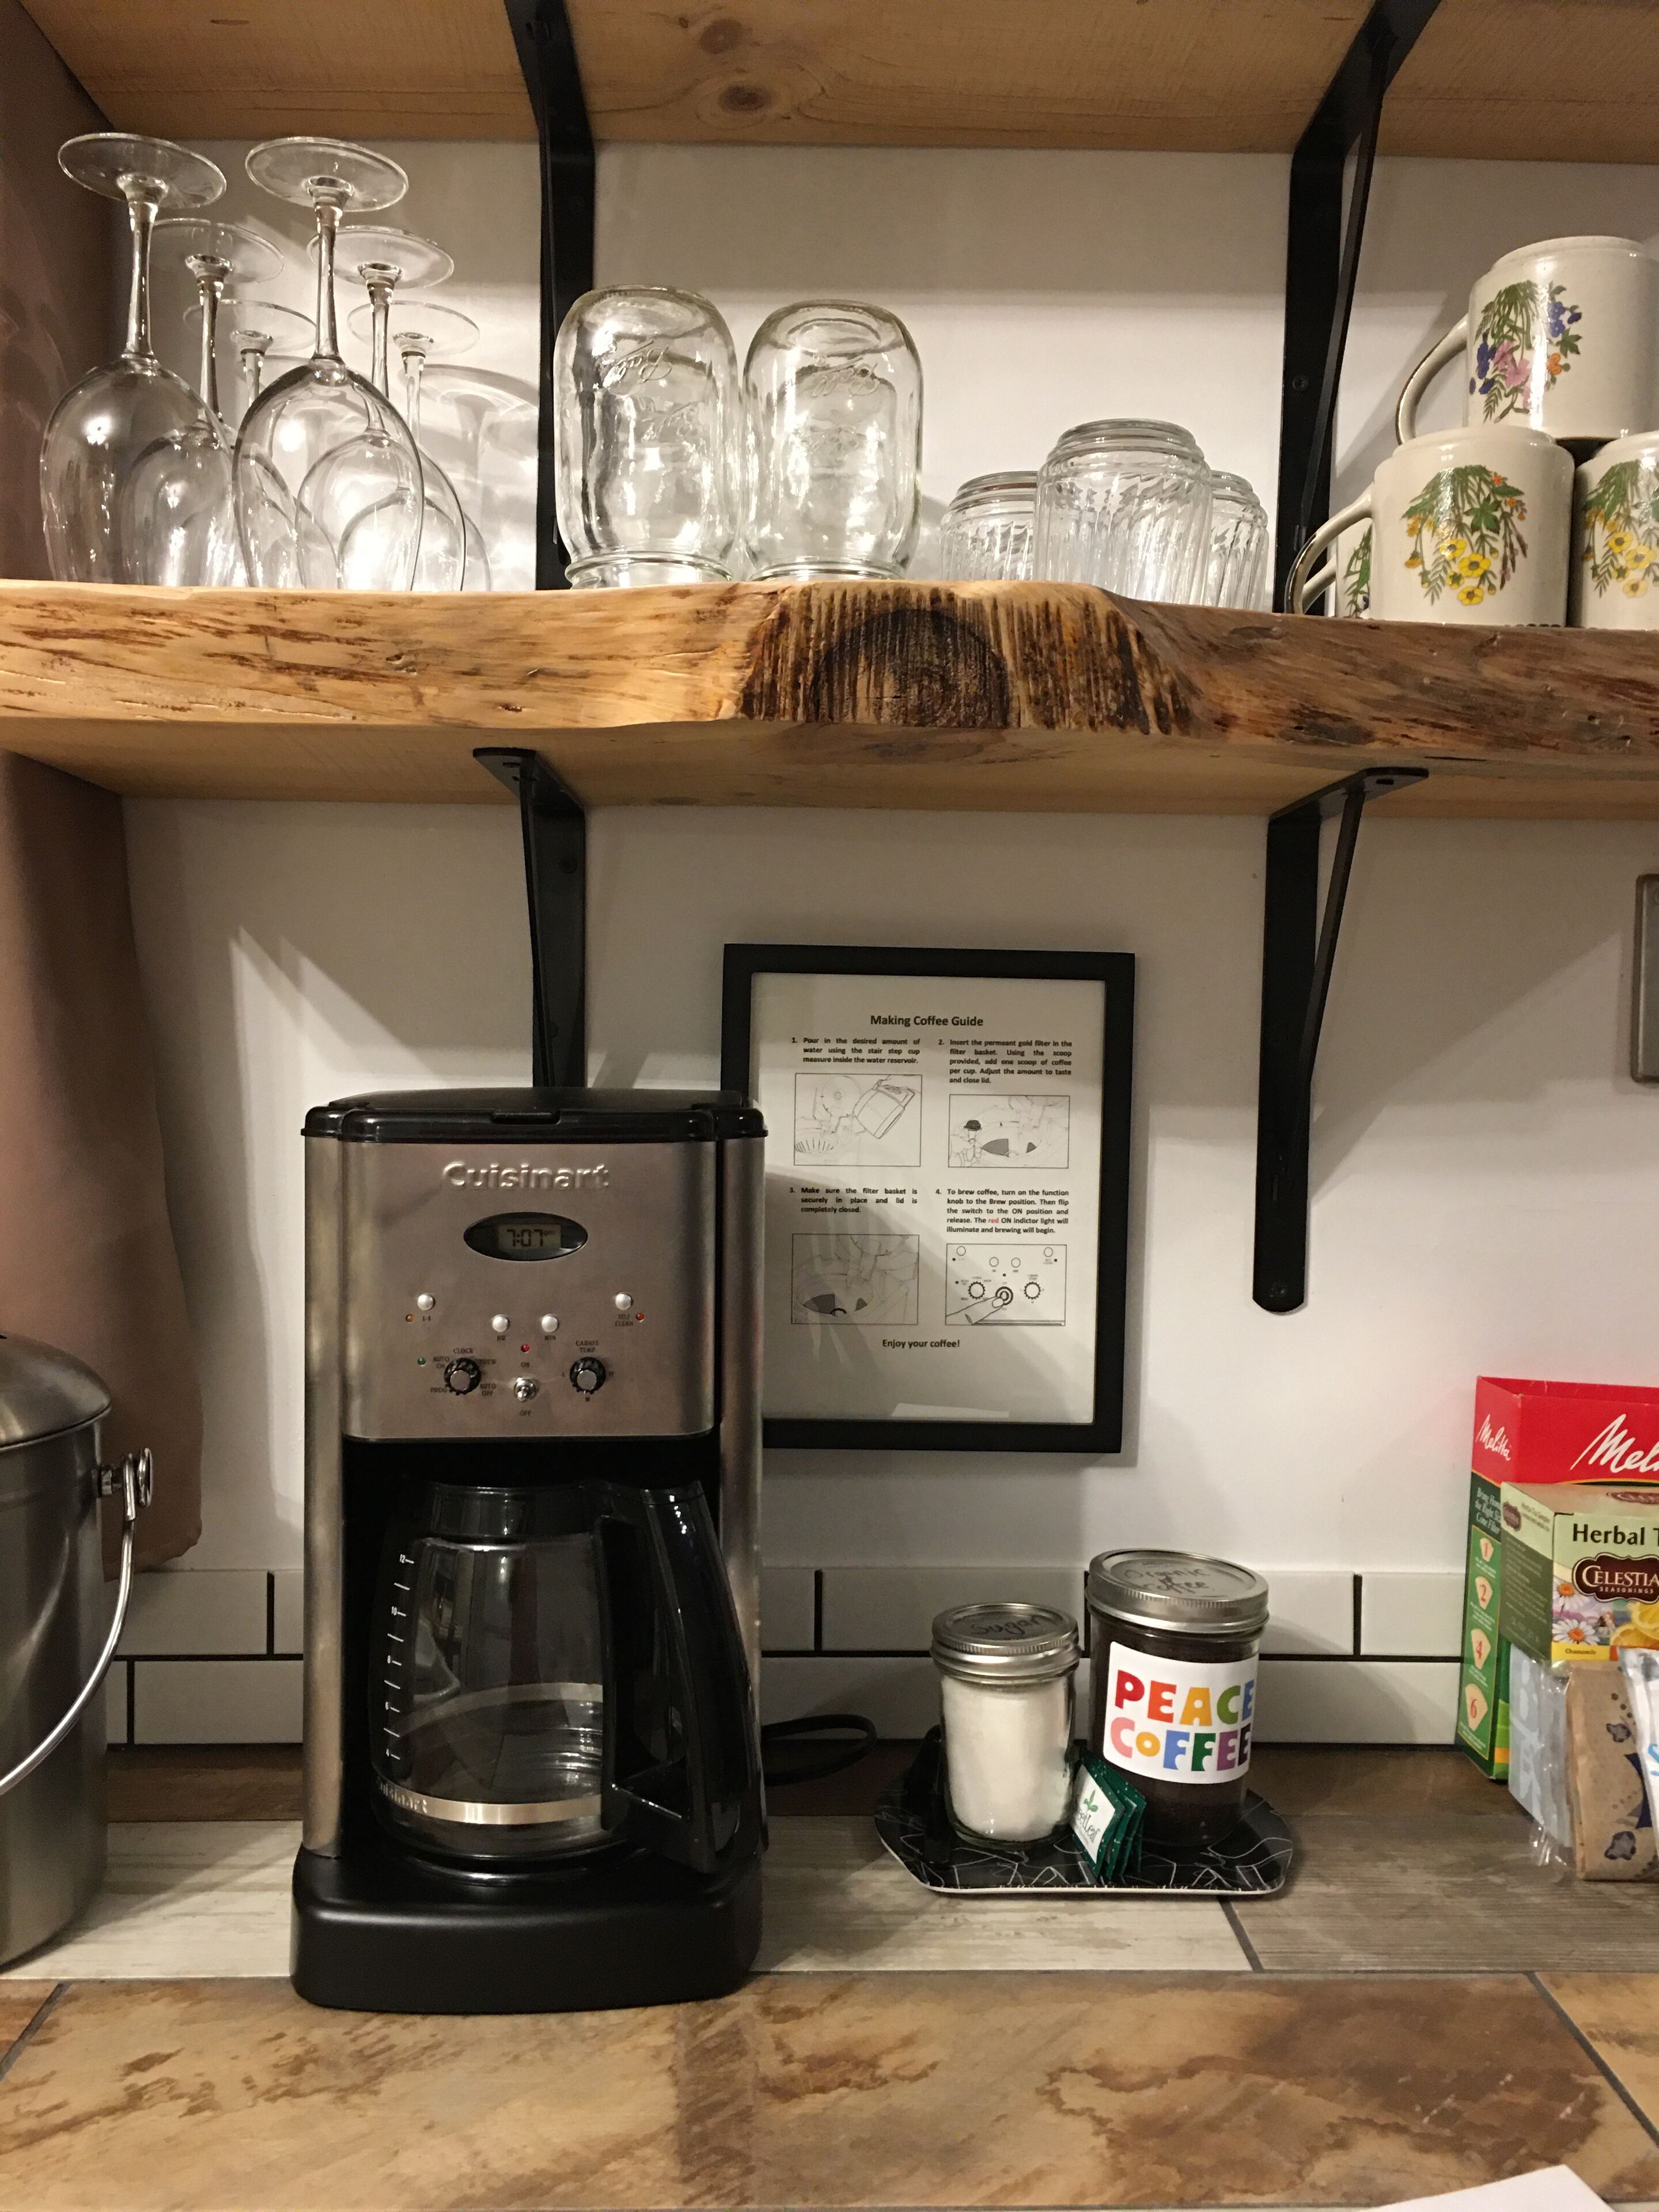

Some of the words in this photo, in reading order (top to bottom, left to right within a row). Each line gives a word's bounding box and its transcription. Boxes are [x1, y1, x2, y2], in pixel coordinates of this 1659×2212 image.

[870, 1015, 911, 1028] Making
[914, 1016, 948, 1026] Coffee
[952, 1016, 983, 1027] Guide
[853, 1037, 877, 1045] desired
[1018, 1039, 1032, 1048] gold
[1035, 1039, 1051, 1047] filter
[828, 1047, 846, 1055] using
[888, 1048, 902, 1056] step
[1007, 1049, 1025, 1057] Using
[949, 1058, 980, 1066] provided,
[1051, 1058, 1071, 1066] coffee
[980, 1067, 1001, 1076] Adjust
[443, 1161, 609, 1189] Cuisinart
[977, 1188, 999, 1196] coffee,
[801, 1196, 828, 1205] securely
[850, 1196, 868, 1205] place
[1009, 1198, 1036, 1206] position.
[1058, 1198, 1069, 1207] flip
[801, 1206, 838, 1214] completely
[1040, 1217, 1055, 1226] light
[995, 1226, 1021, 1234] brewing
[1036, 1226, 1055, 1235] begin.
[506, 1229, 543, 1247] 7:07
[882, 1339, 906, 1349] Enjoy
[908, 1341, 928, 1349] your
[930, 1339, 960, 1348] coffee!
[1475, 1414, 1512, 1461] Melitta
[1570, 1414, 1659, 1474] Mel
[1573, 1523, 1645, 1546] Herbal
[399, 1554, 406, 1563] 12
[1582, 1565, 1659, 1587] CELESTIA
[1479, 1584, 1487, 1602] 2
[1599, 1586, 1654, 1594] SEASONINGS
[391, 1606, 397, 1616] 10
[971, 1614, 1041, 1636] Sugar
[1476, 1641, 1482, 1659] 4
[387, 1655, 391, 1664] 8
[1115, 1669, 1255, 1727] PEACE
[385, 1701, 389, 1710] 6
[1471, 1699, 1477, 1719] 6
[1109, 1717, 1251, 1773] COFFEE
[386, 1748, 390, 1757] 4
